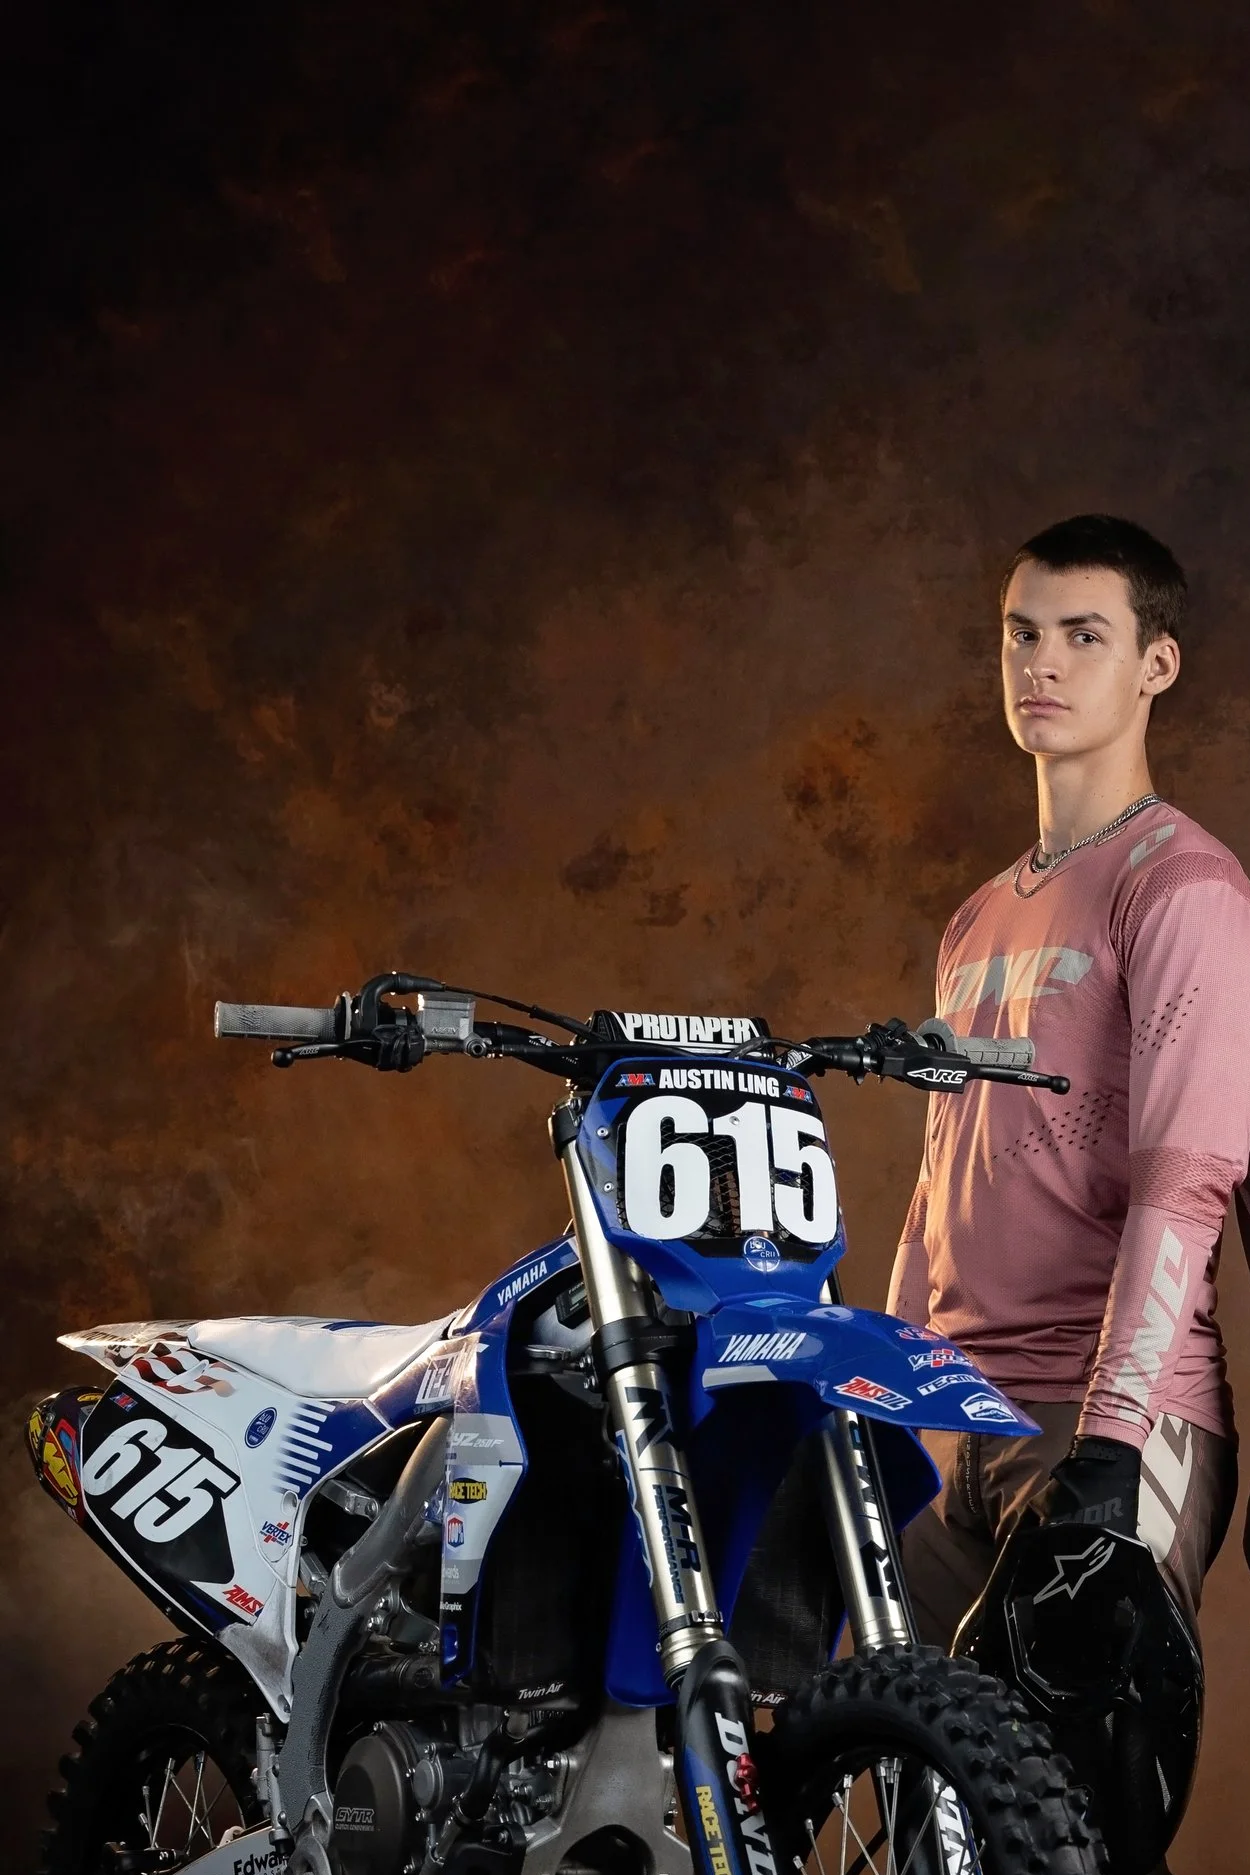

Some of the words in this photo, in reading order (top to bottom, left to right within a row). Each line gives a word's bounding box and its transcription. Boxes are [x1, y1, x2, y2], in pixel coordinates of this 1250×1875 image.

[624, 1012, 752, 1046] PROTAPER
[615, 1073, 656, 1088] AMA
[659, 1068, 731, 1091] AUSTIN
[738, 1071, 780, 1098] LING
[906, 1067, 967, 1084] ARC
[1017, 1072, 1040, 1082] ARC
[624, 1095, 838, 1243] 615
[496, 1260, 548, 1306] YAMAHA
[717, 1333, 807, 1363] YAMAHA
[836, 1377, 911, 1410] AMSOIL
[83, 1418, 237, 1544] 615
[261, 1520, 293, 1544] VERTEX
[652, 1483, 685, 1605] PERFORMANCE
[518, 1686, 546, 1700] Twin
[546, 1682, 564, 1695] Air
[762, 1690, 789, 1704] Air
[335, 1806, 376, 1823] GYTR
[696, 1785, 723, 1841] RACE
